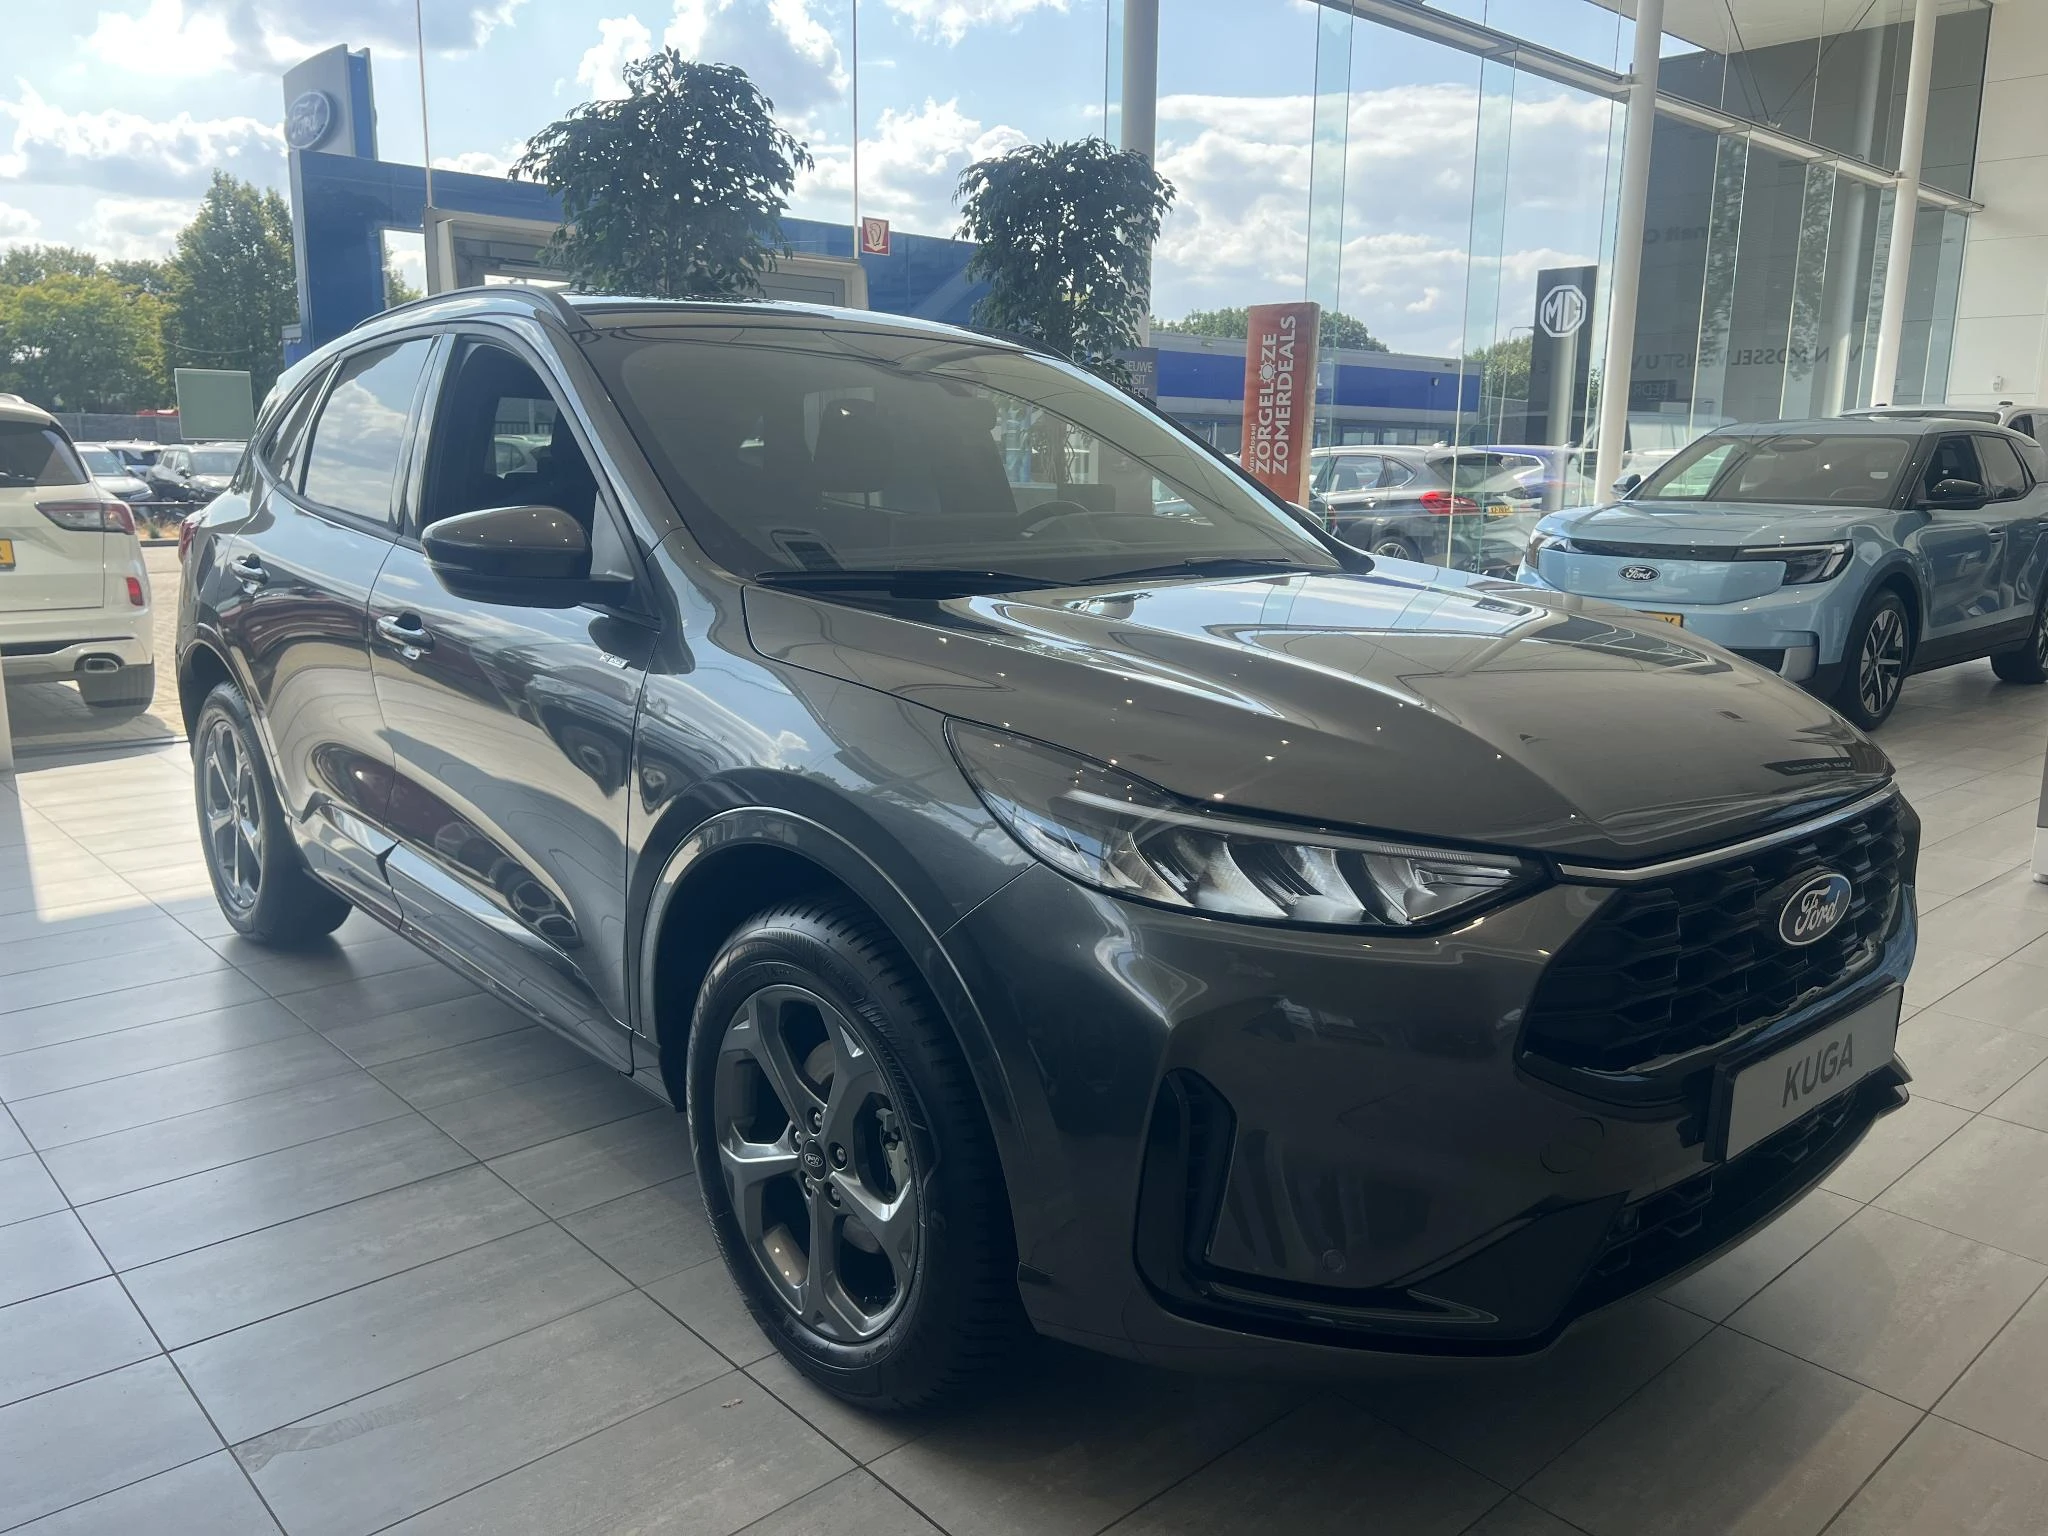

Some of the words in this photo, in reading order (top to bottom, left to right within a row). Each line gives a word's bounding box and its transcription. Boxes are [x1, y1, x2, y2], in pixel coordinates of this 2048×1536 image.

[1545, 291, 1581, 331] MG
[1120, 360, 1153, 373] IEUWE
[1272, 315, 1297, 475] ZOMERDEALS
[1248, 456, 1256, 474] Van
[1625, 567, 1652, 580] Ford
[1795, 885, 1840, 936] Ford
[1782, 1032, 1853, 1108] KUGA
